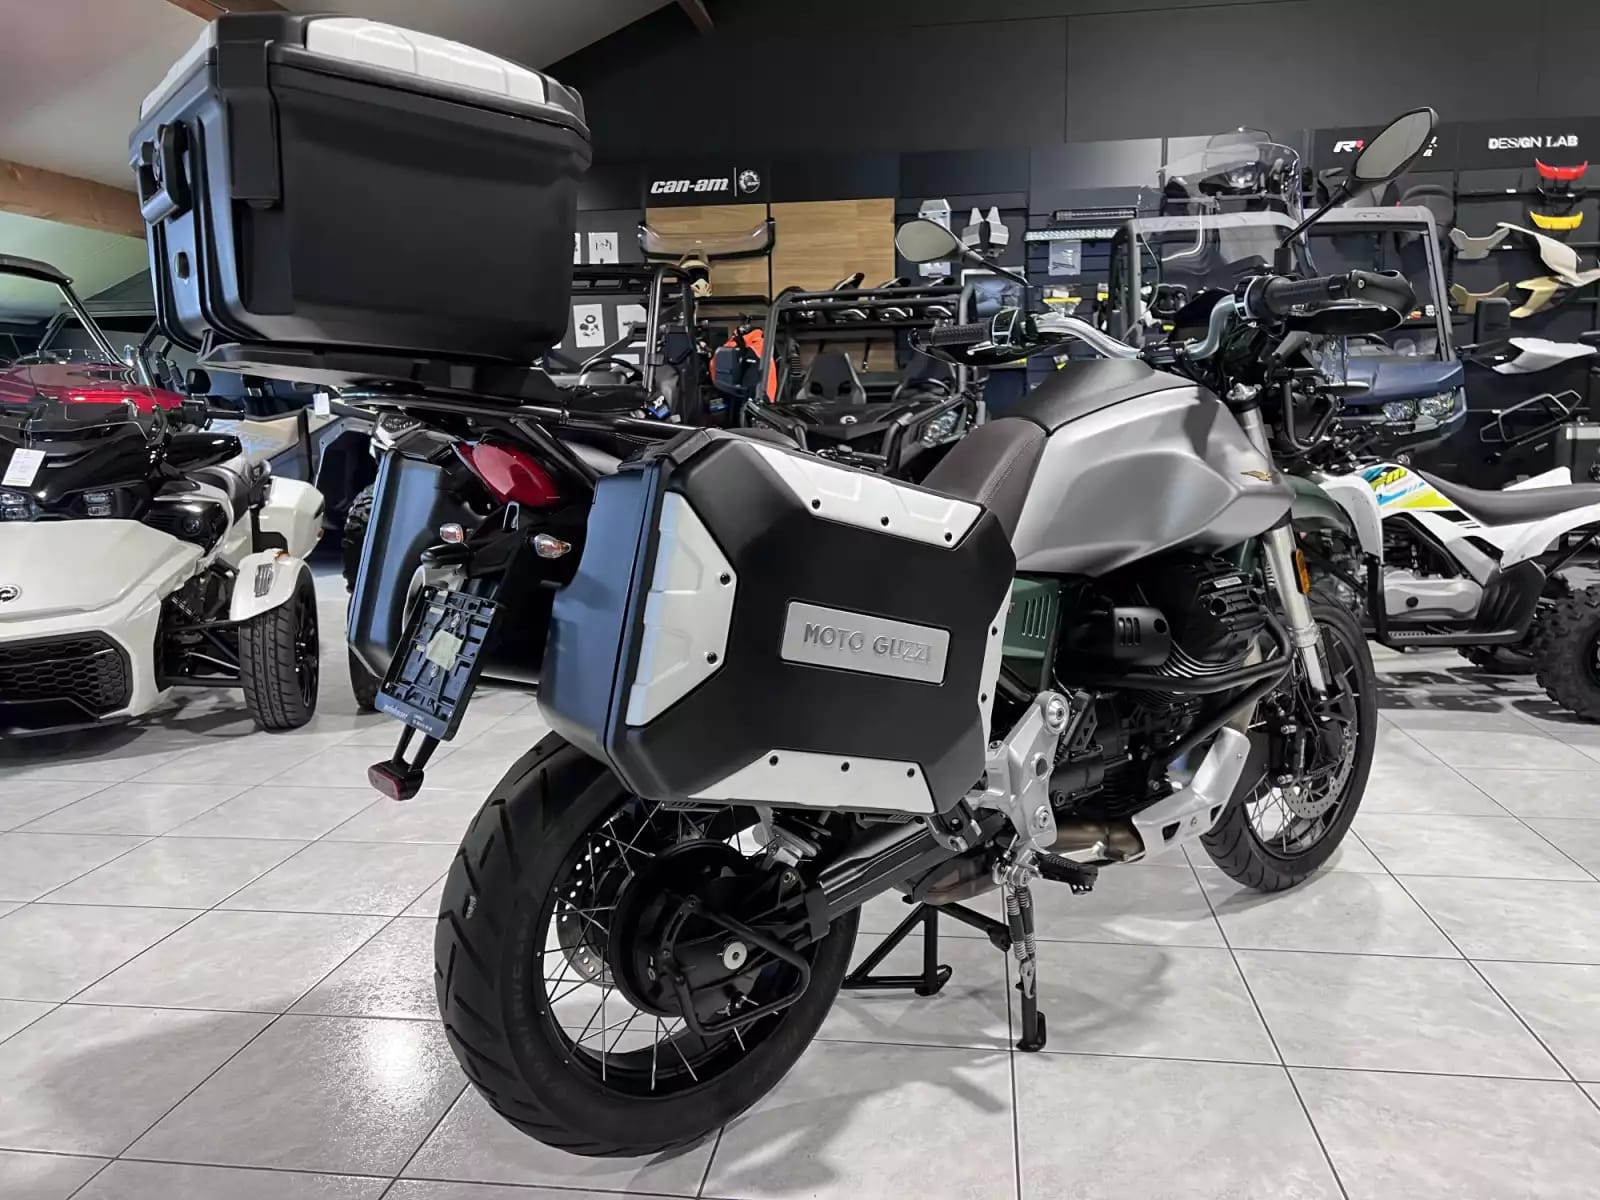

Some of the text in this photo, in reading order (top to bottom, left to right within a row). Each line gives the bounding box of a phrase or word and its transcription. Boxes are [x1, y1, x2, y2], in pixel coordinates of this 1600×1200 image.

[1488, 135, 1578, 149] DESIGN LAB
[650, 178, 728, 194] can-am
[803, 622, 932, 665] MOTO GUZZI
